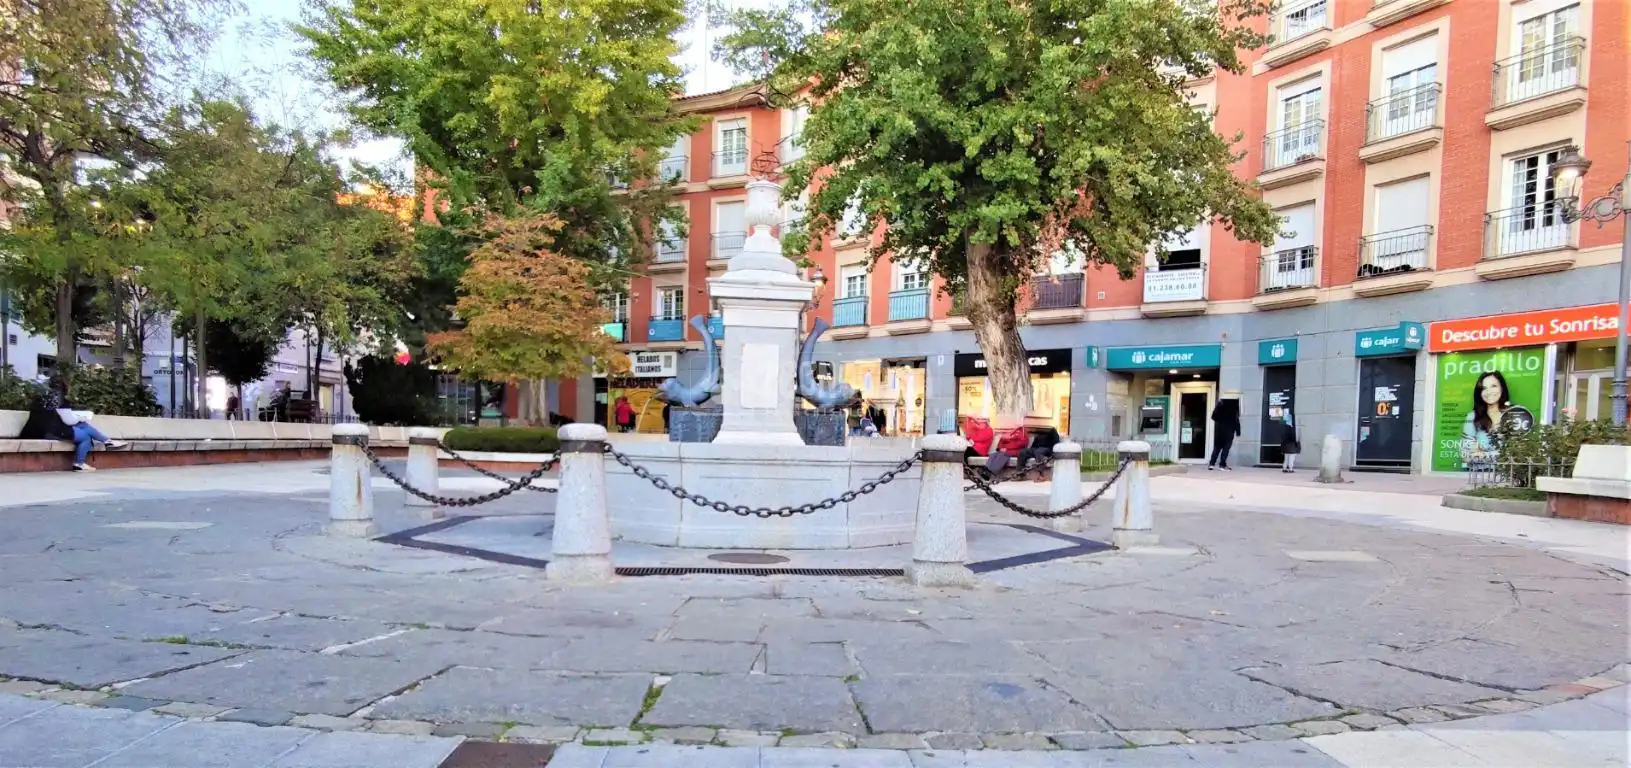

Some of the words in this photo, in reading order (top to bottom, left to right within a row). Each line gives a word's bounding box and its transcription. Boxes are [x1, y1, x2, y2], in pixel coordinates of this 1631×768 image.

[1441, 325, 1518, 344] Descubre
[1524, 322, 1543, 336] tu
[1549, 315, 1618, 334] Sonrisa
[1148, 350, 1193, 363] cajamar
[1444, 352, 1540, 379] pradillo
[635, 365, 661, 373] ITALIANOS
